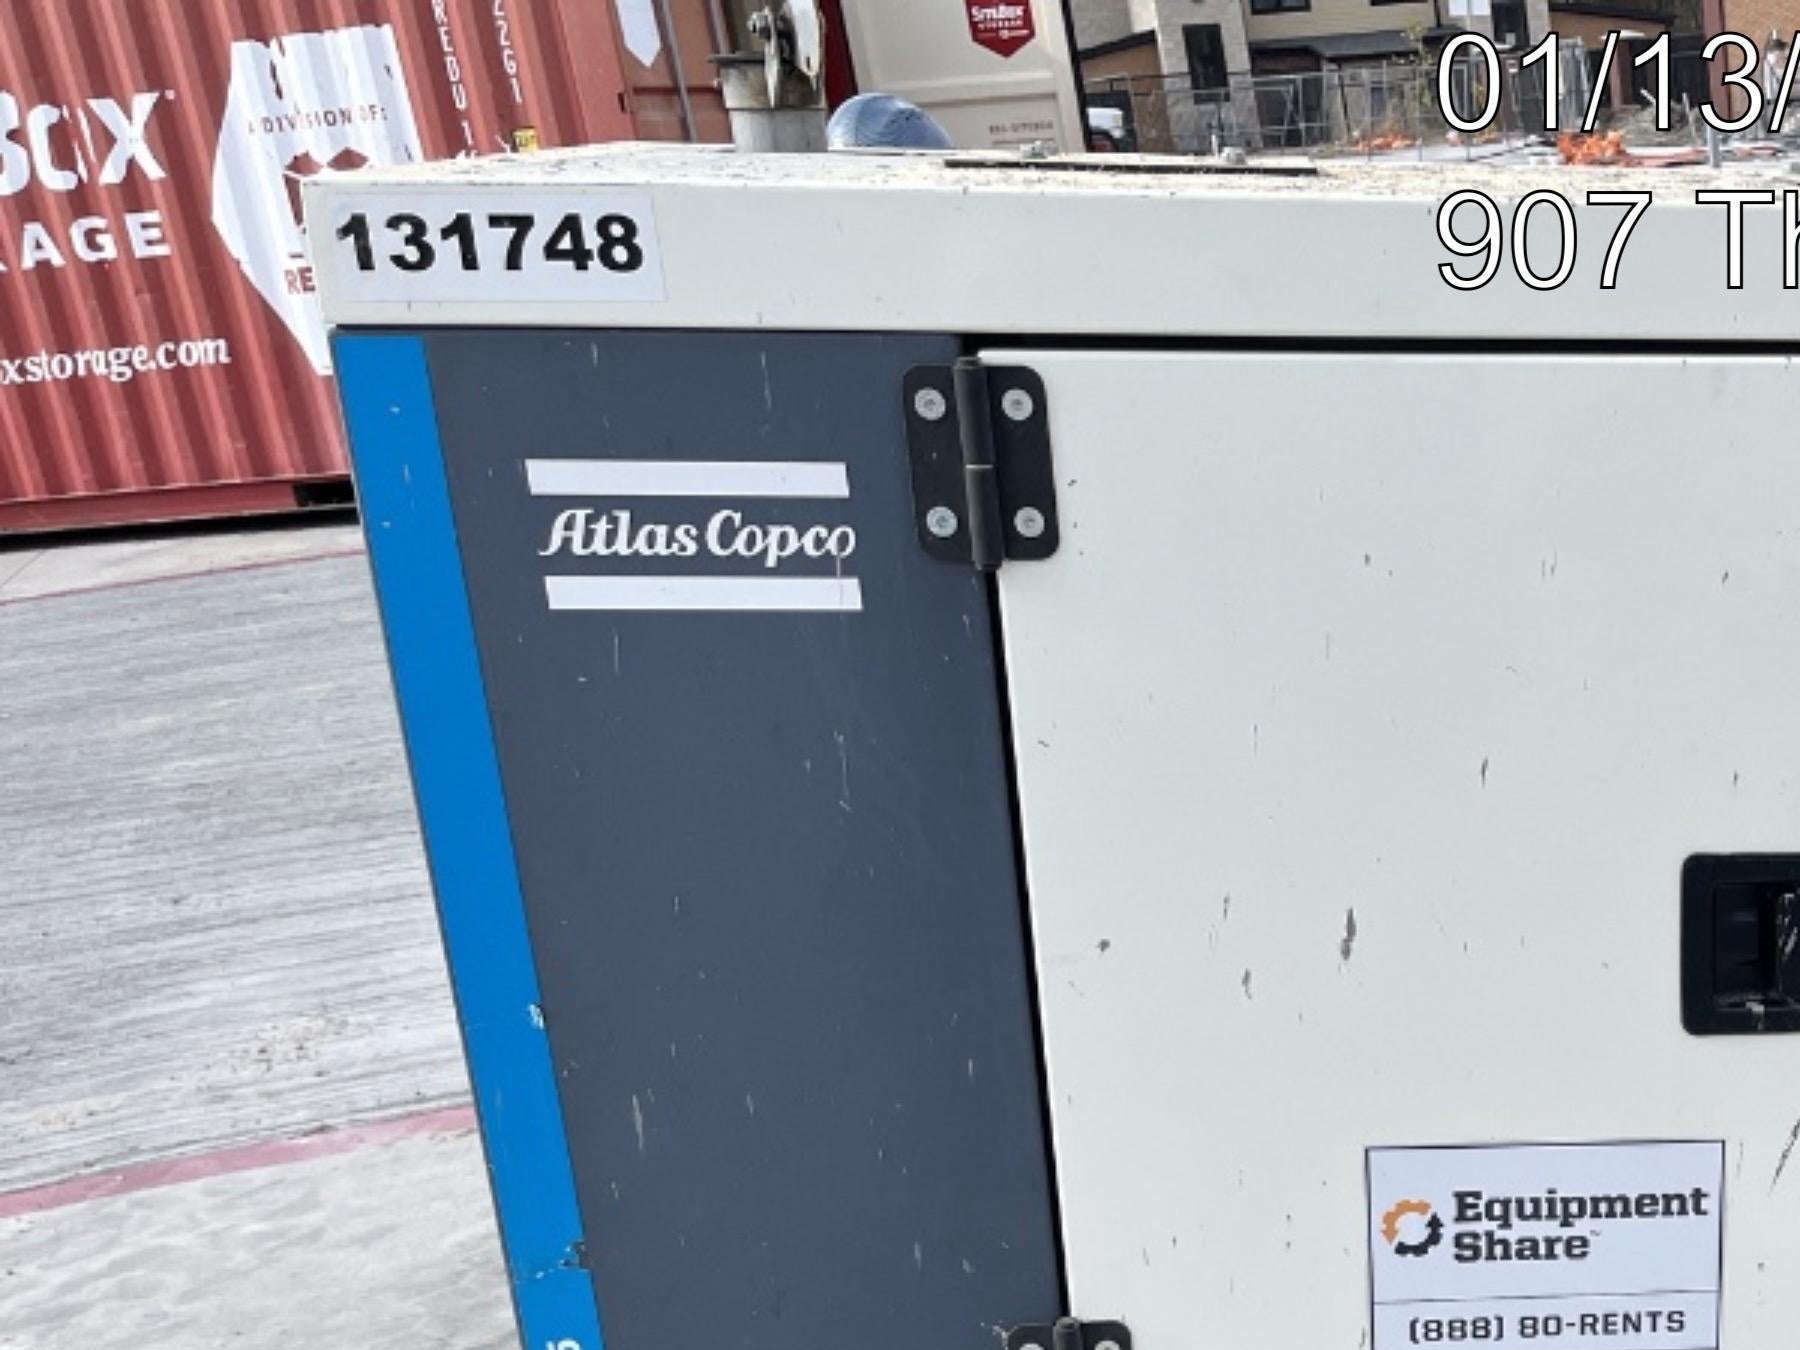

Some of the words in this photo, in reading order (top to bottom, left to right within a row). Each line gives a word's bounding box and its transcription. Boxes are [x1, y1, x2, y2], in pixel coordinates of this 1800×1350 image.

[0, 209, 172, 271] AGE
[336, 212, 644, 273] 131748
[537, 508, 699, 557] Atlas
[705, 508, 857, 569] Copco
[1453, 1187, 1711, 1230] Equipment
[1453, 1230, 1591, 1264] Share
[1409, 1315, 1504, 1344] (888)
[1518, 1309, 1686, 1339] 80-RENTS
